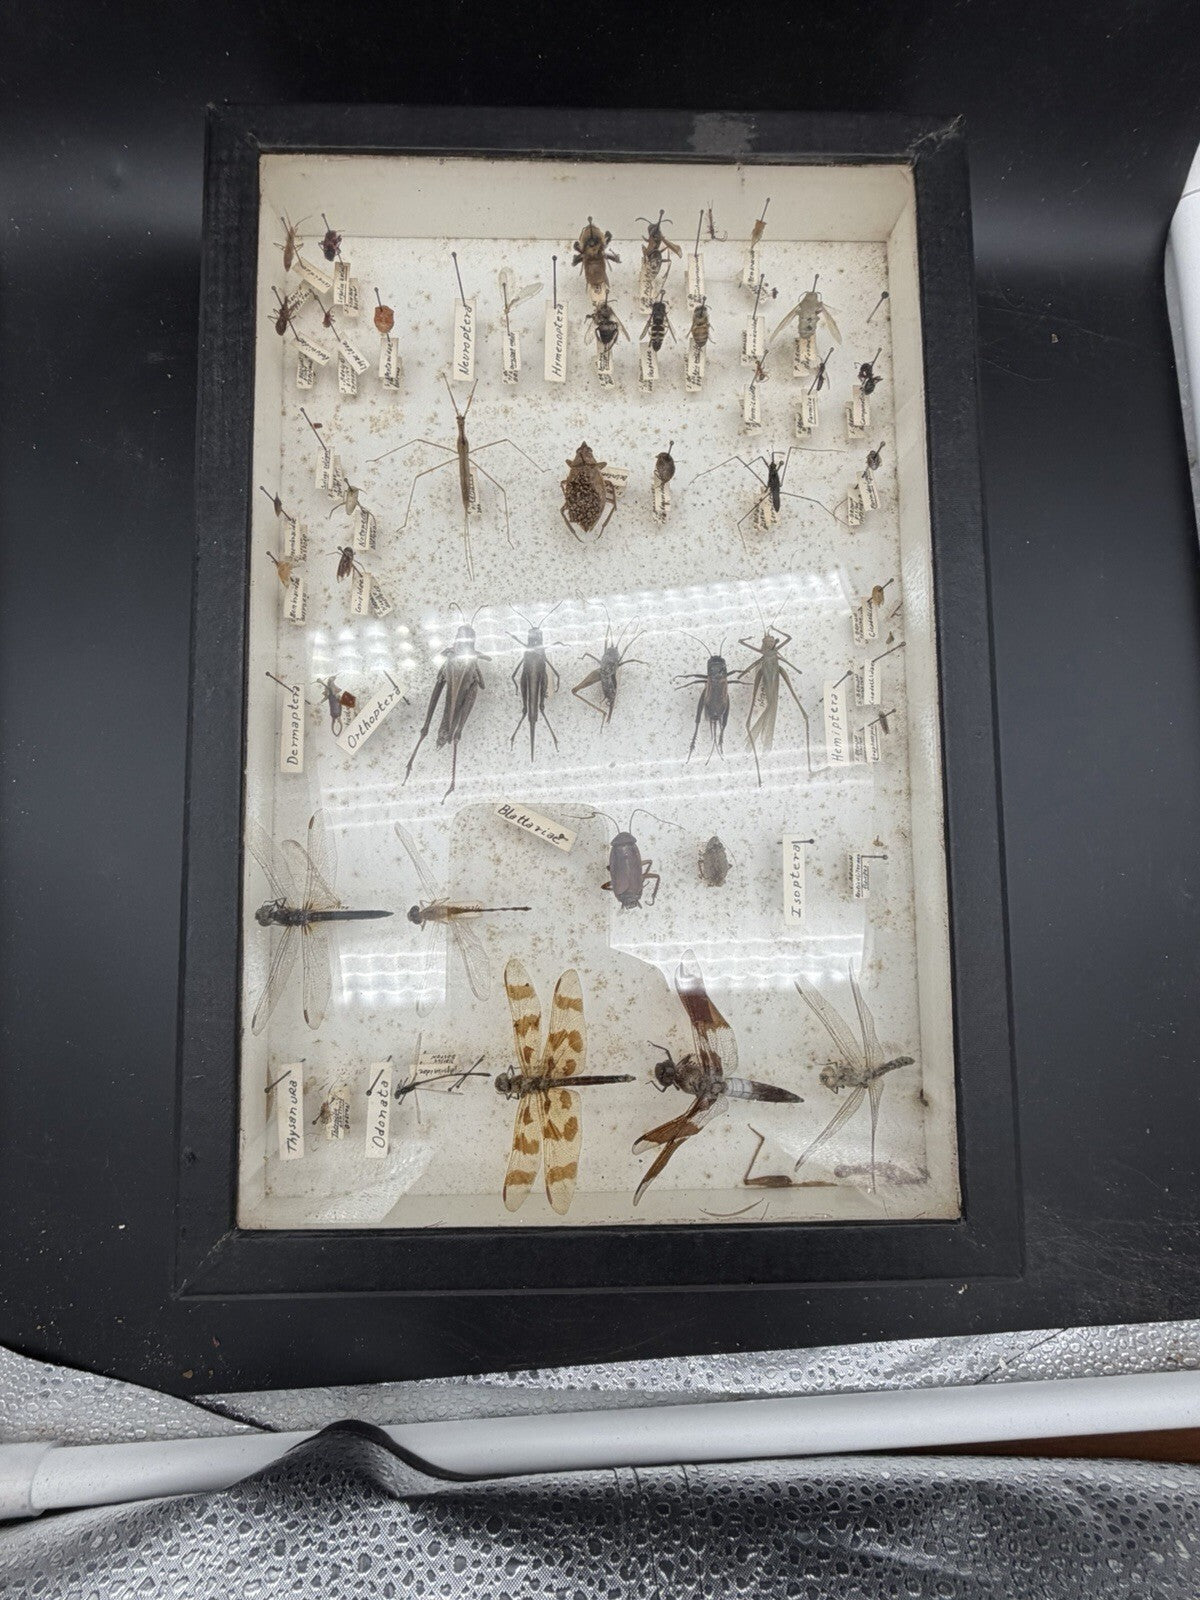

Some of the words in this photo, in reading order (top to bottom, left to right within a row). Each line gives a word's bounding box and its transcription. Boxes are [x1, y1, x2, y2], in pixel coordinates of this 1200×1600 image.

[458, 304, 473, 375] Neuroptera
[552, 303, 564, 377] Hymenoptera
[286, 685, 301, 766] Dermaptera
[347, 687, 401, 749] Orthoptera
[829, 693, 844, 762] Hemiptera
[497, 804, 561, 845] Blattariae
[789, 844, 802, 918] Isoptera
[371, 1080, 389, 1149] Odonata
